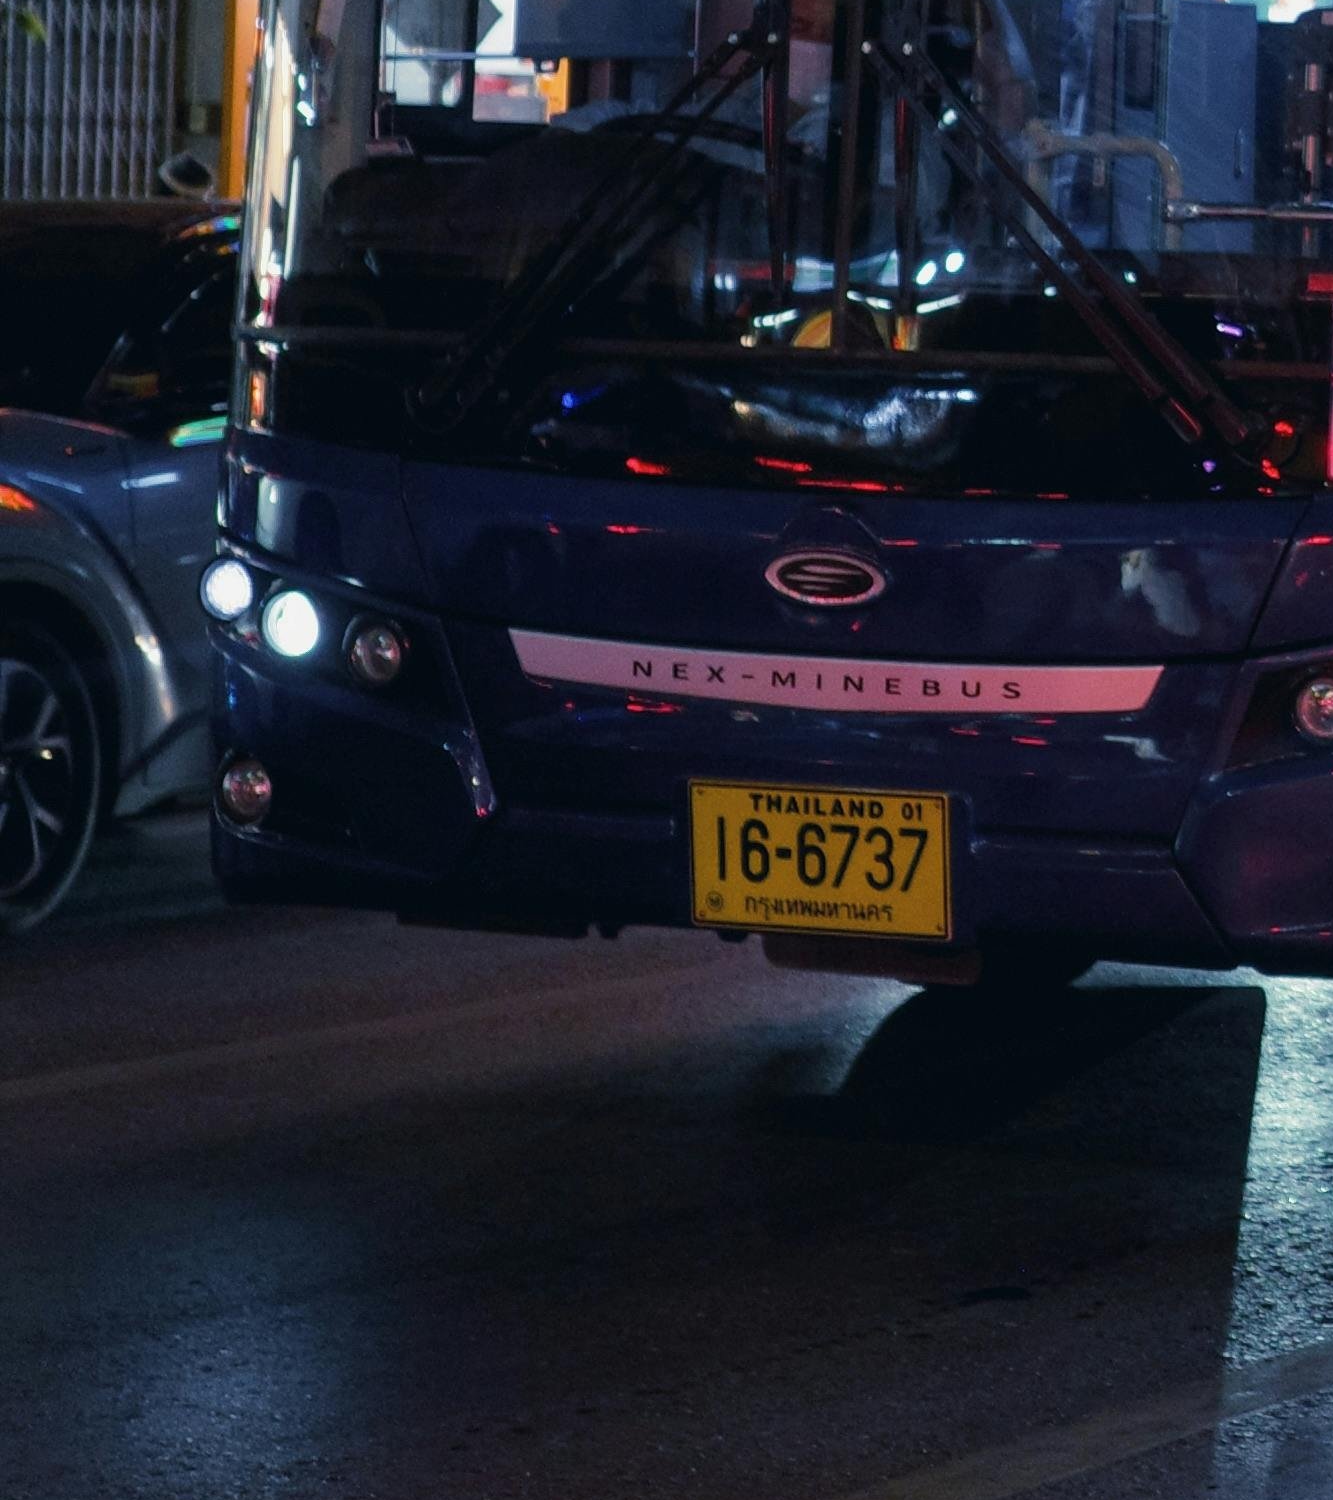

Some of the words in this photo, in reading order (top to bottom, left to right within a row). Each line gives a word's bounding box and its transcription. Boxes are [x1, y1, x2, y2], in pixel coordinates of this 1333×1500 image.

[632, 658, 1022, 700] NEX-MINEBUS
[750, 793, 884, 819] THAILAND
[902, 803, 922, 821] 01
[717, 816, 928, 892] 16-6737
[745, 896, 892, 922] กรุงเทพมหานคร
